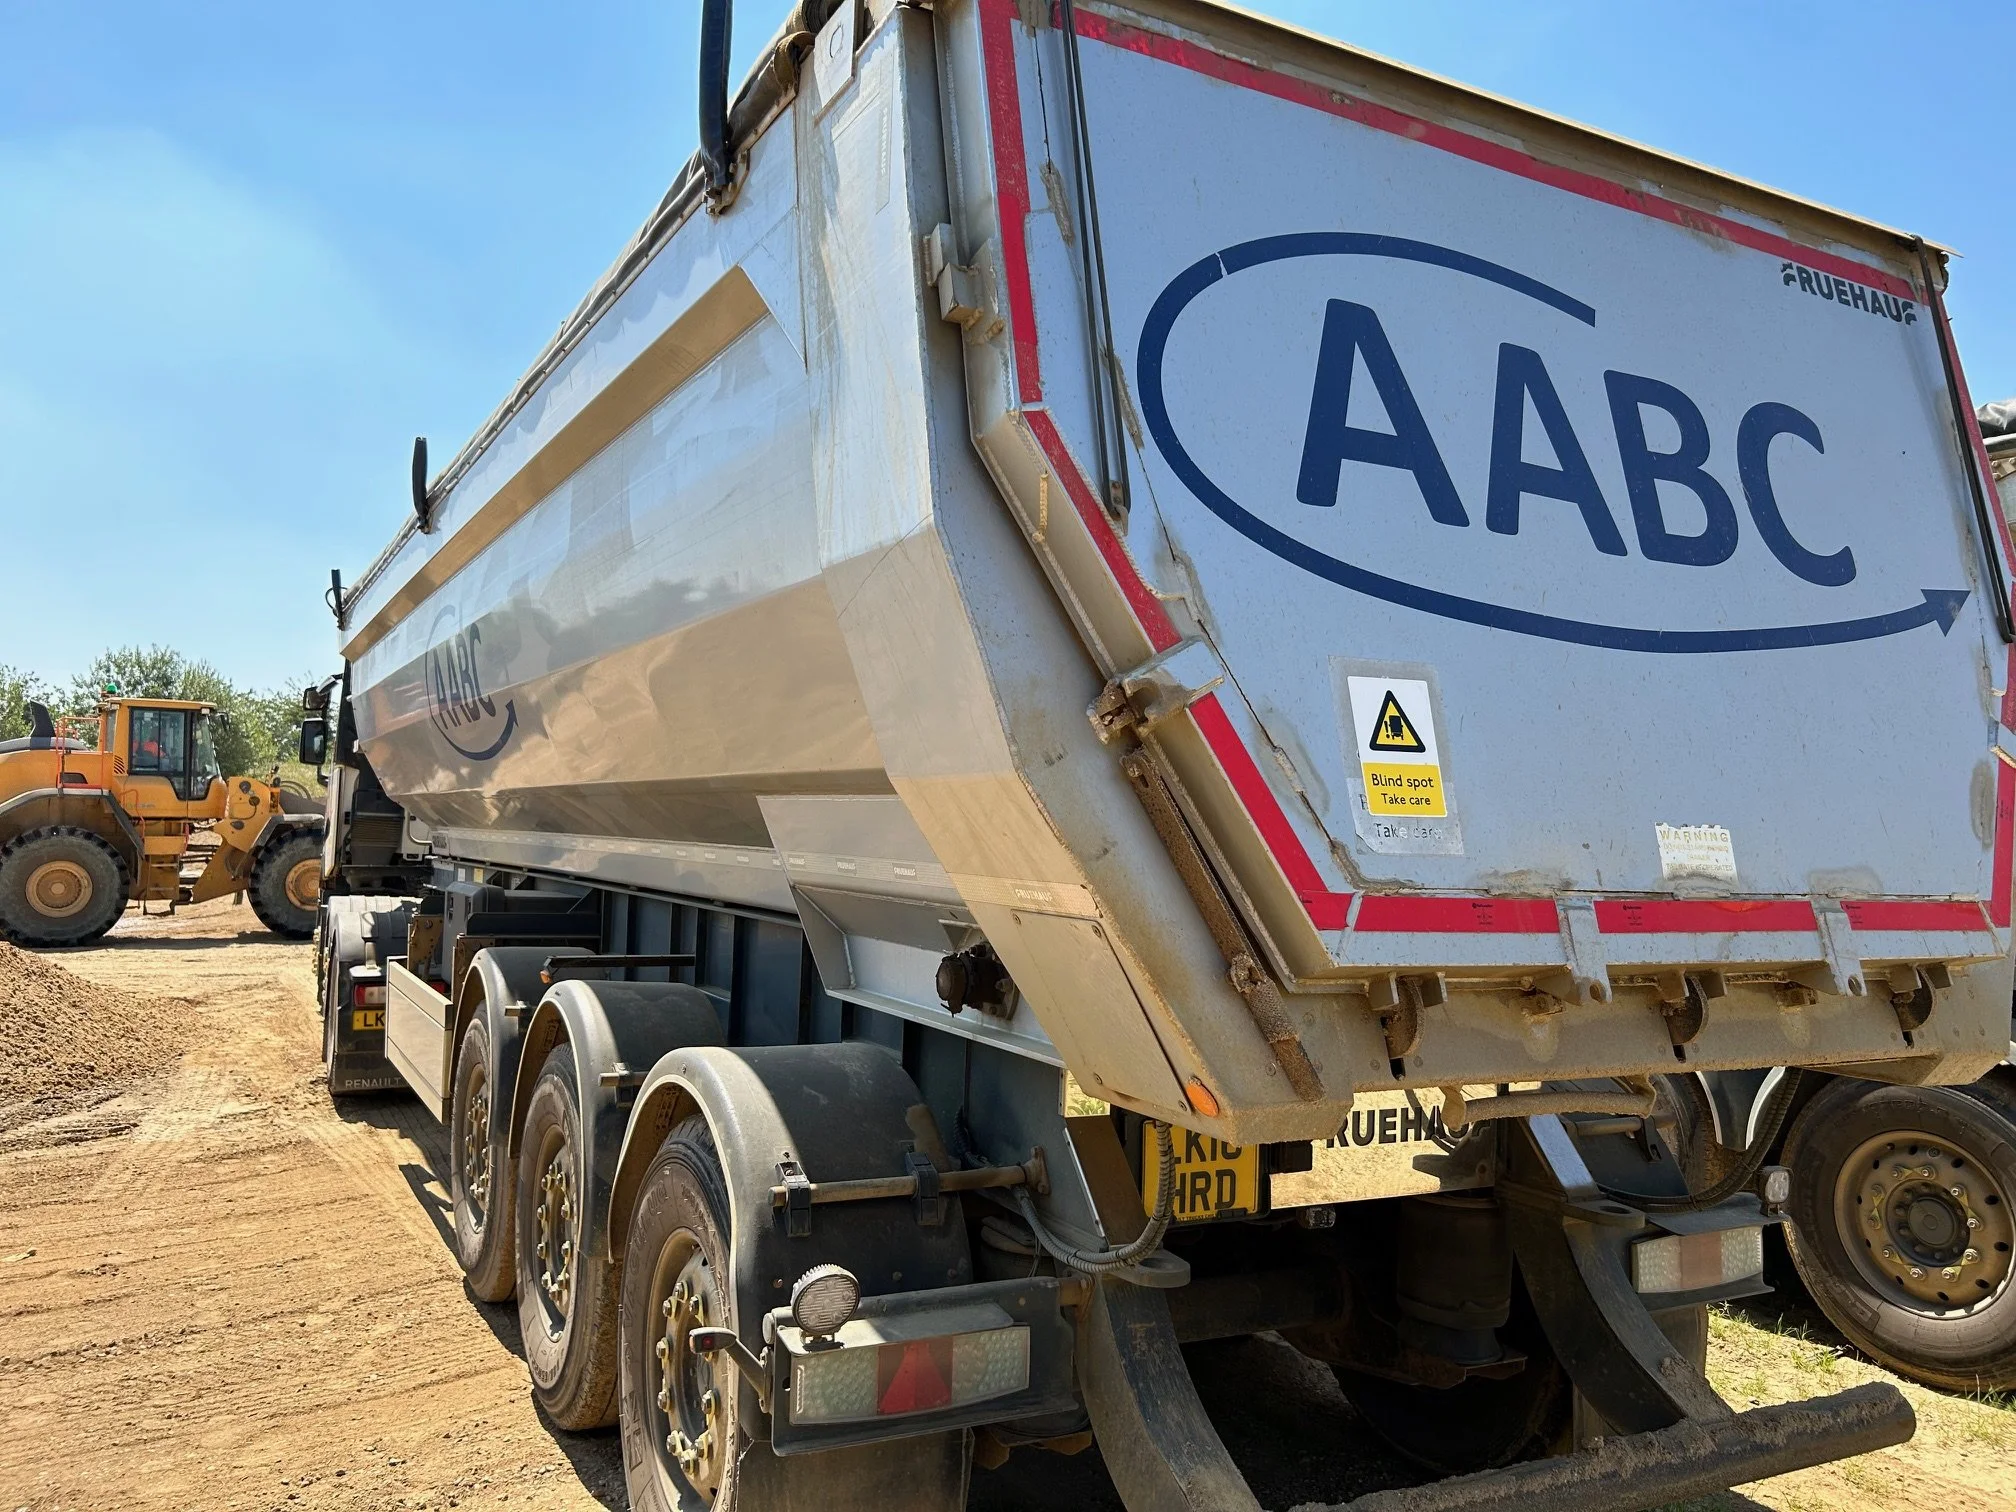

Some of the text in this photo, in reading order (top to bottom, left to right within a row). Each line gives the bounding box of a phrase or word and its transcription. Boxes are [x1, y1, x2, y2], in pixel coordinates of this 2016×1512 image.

[1296, 299, 1857, 587] AABC
[432, 622, 497, 730] AABC
[1371, 773, 1434, 791] Blind spot
[1381, 793, 1406, 805] Take
[1409, 796, 1431, 806] care
[1659, 829, 1729, 843] WARNING
[345, 1077, 401, 1089] RENAULT
